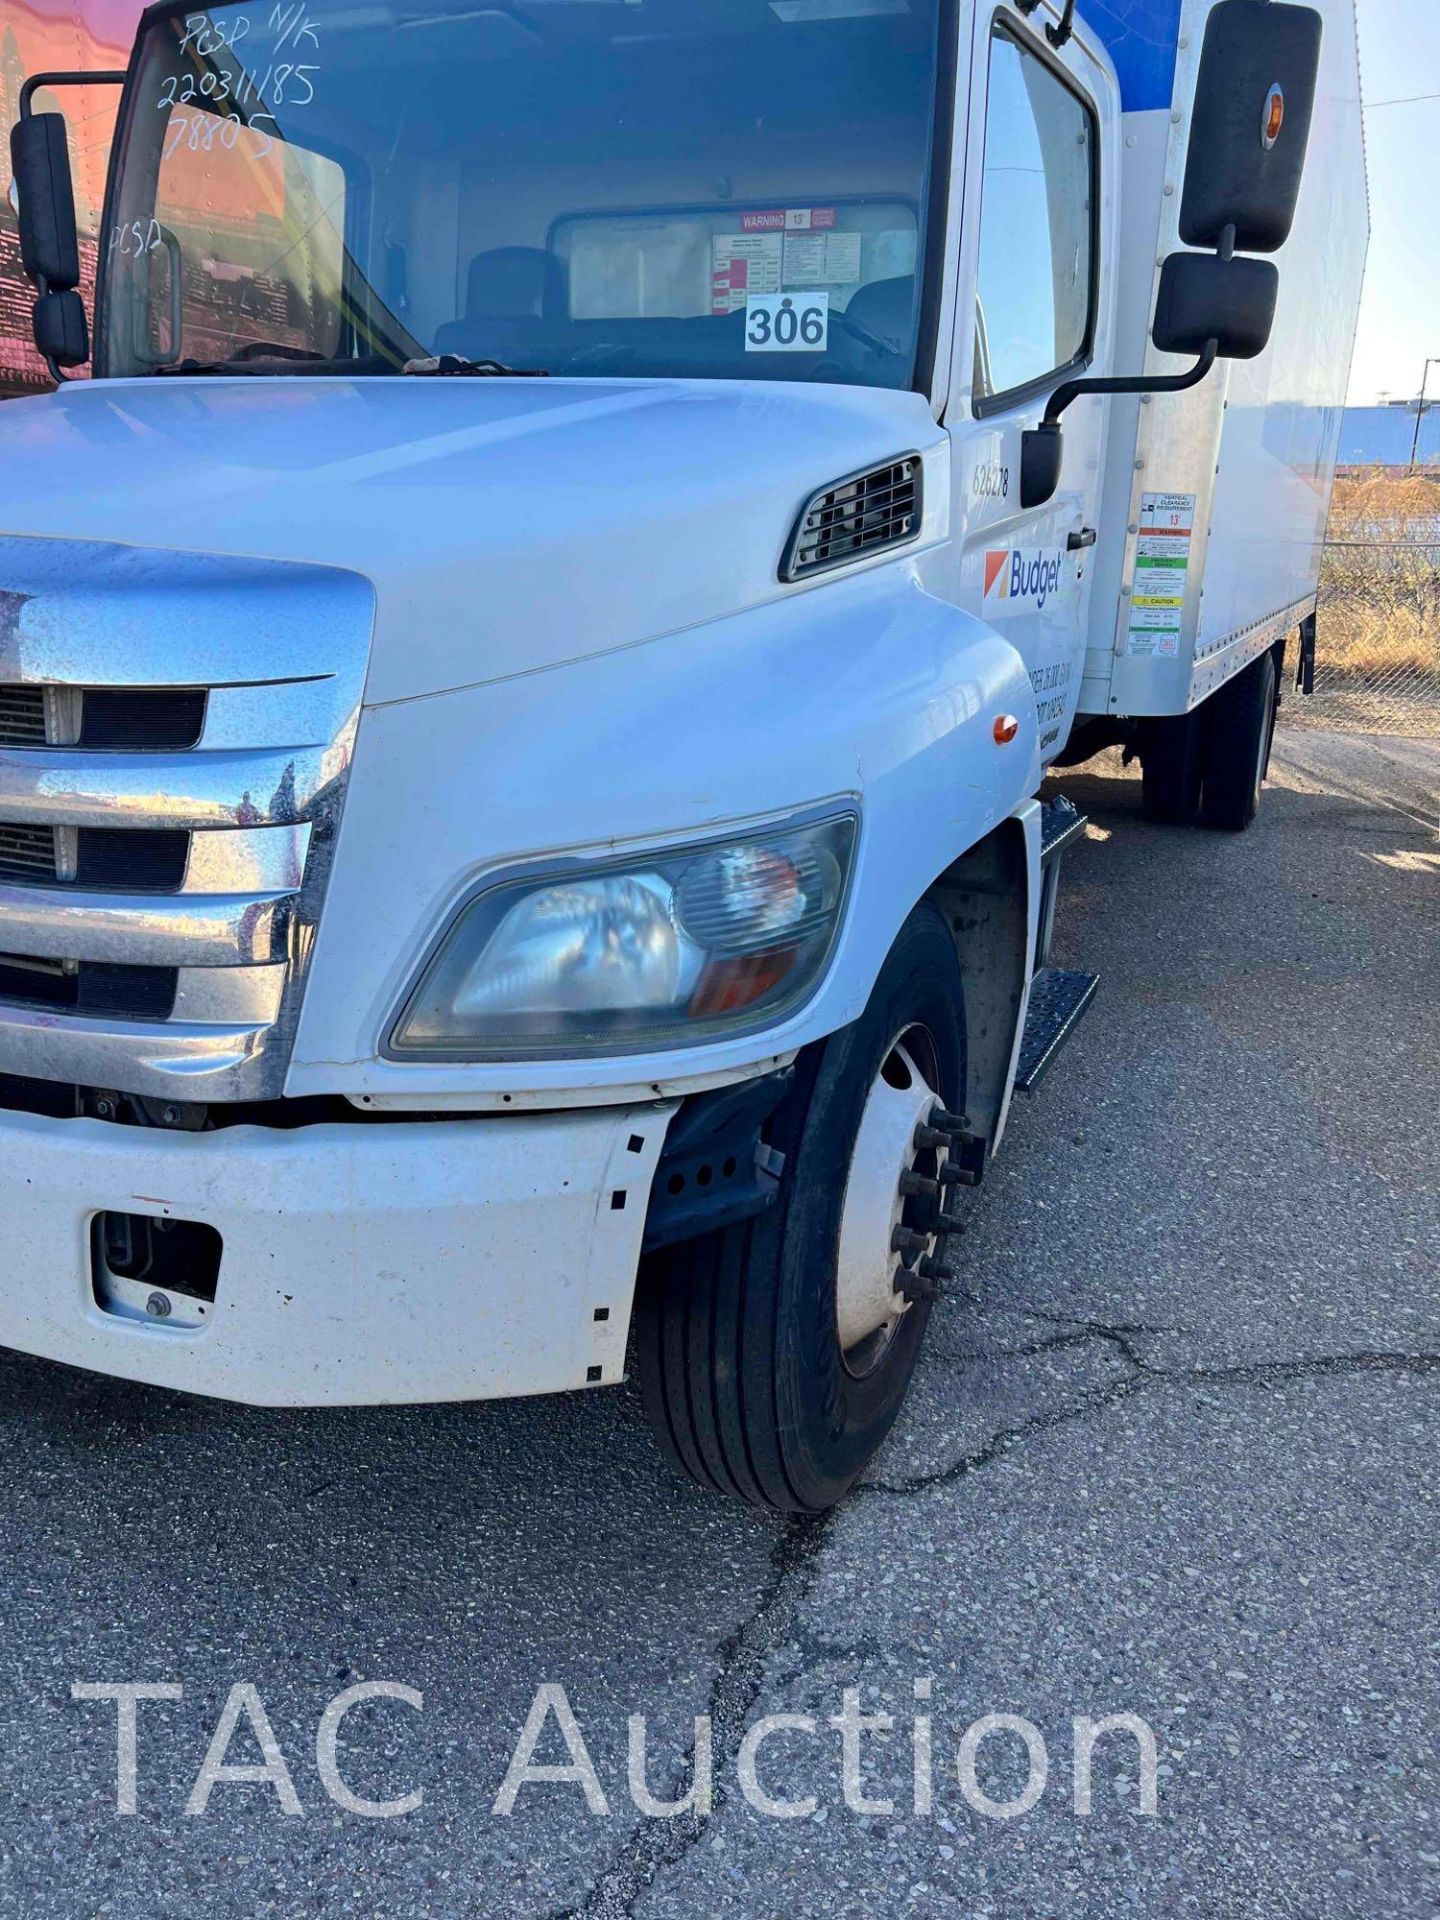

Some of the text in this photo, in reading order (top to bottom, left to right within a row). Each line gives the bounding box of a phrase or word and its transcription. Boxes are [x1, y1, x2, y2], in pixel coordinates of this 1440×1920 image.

[157, 64, 320, 108] 220311185
[162, 113, 275, 159] 78805
[743, 214, 784, 227] WARNING
[748, 307, 824, 345] 306
[972, 464, 1009, 497] 626278
[1010, 550, 1062, 609] Budget
